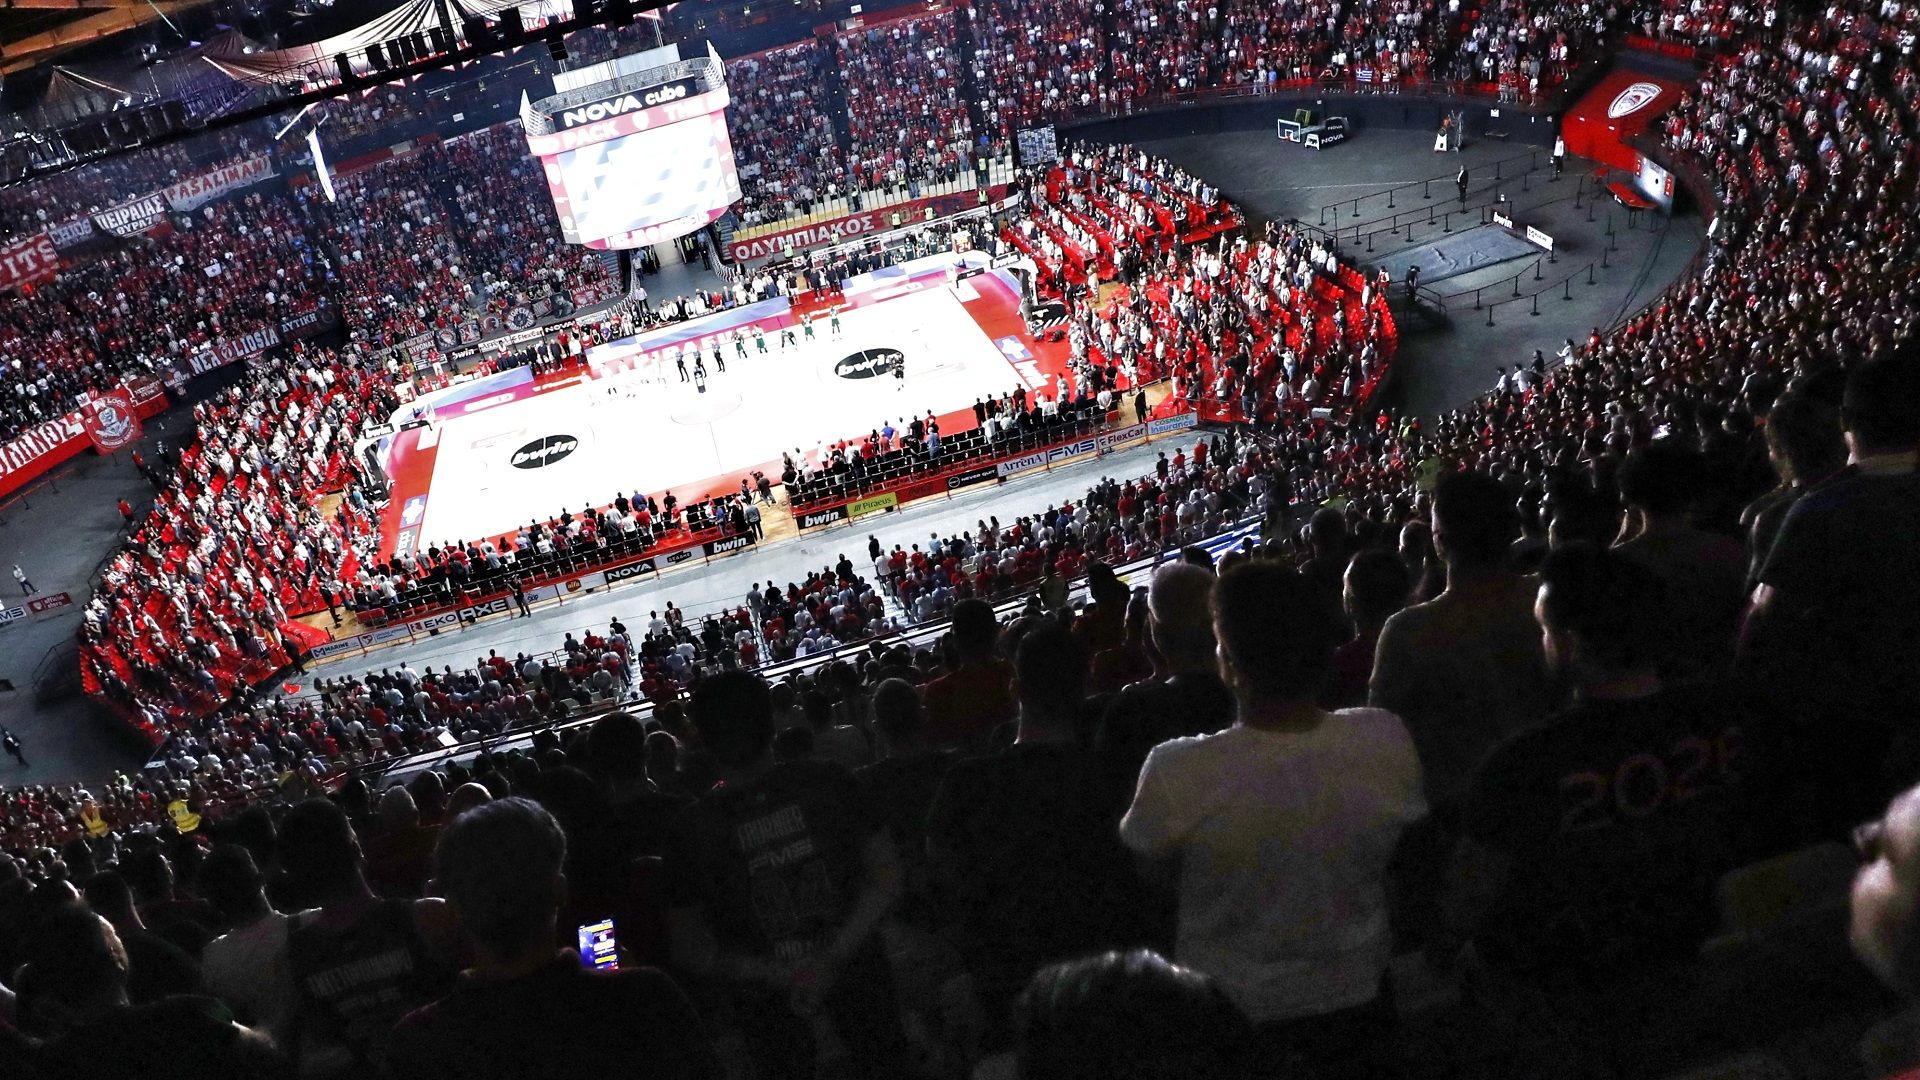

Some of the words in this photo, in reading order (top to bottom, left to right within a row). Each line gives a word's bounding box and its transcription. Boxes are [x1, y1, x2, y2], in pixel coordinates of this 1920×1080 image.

[563, 96, 642, 128] NOVA
[645, 85, 686, 105] cube
[562, 121, 620, 149] PACK
[1321, 134, 1344, 144] NOVA
[95, 195, 165, 231] ΠΕΙΡΑΙΑΣ
[1493, 212, 1513, 229] bwin
[735, 215, 875, 261] ΟΛΥΜΠΙΑΚΟΣ
[281, 312, 317, 333] ΔΥΤΙΚΗ
[545, 321, 576, 333] NOVA
[230, 328, 280, 357] LIOSIA
[838, 352, 902, 376] bwin
[1154, 413, 1190, 427] COSMOTE
[1107, 427, 1144, 445] FlexCar
[511, 441, 577, 464] bwin
[1049, 439, 1095, 461] FMS
[961, 473, 981, 482] NEVER
[863, 496, 892, 509] Piraeus
[804, 510, 840, 528] bwin
[713, 537, 747, 553] bwin
[607, 563, 653, 580] NOVA
[0, 607, 25, 621] MS
[459, 601, 508, 620] AXE
[424, 614, 457, 628] EKO
[325, 642, 349, 652] MARINE
